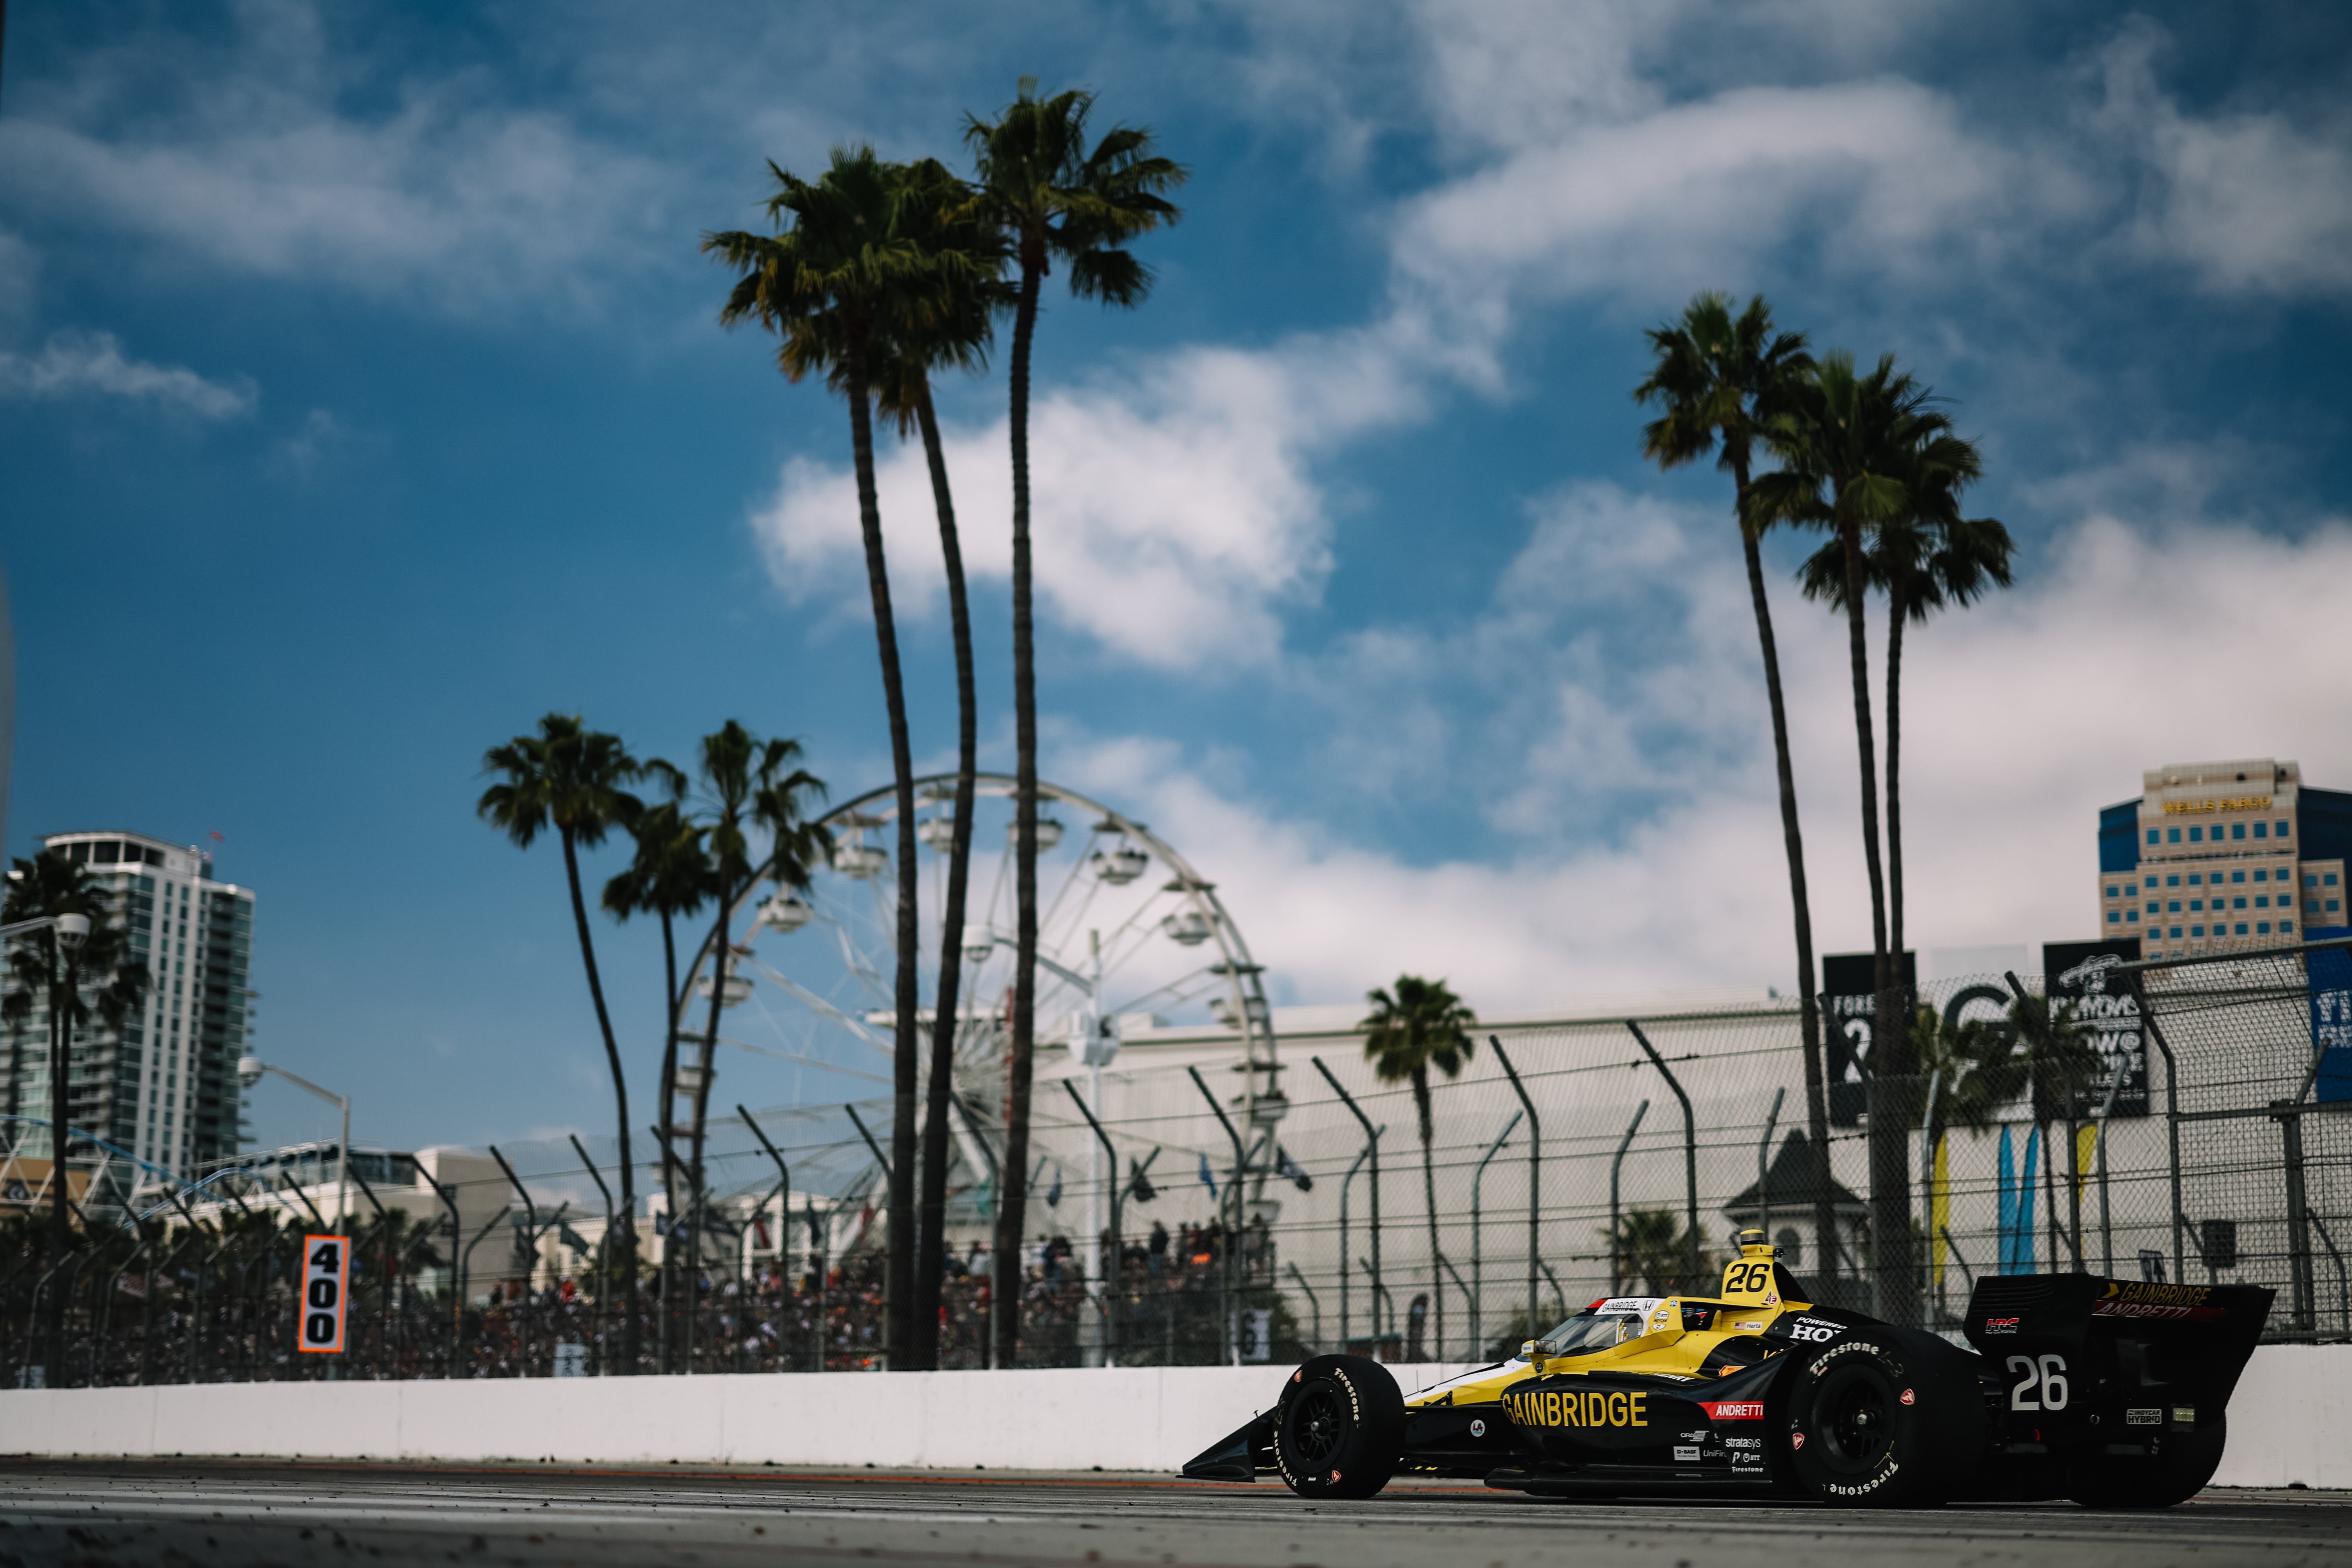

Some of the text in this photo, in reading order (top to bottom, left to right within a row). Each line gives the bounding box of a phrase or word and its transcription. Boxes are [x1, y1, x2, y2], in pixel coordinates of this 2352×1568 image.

[2219, 796, 2272, 812] FARGO
[1725, 1263, 1770, 1293] 26
[307, 1243, 339, 1343] 400
[2120, 1283, 2211, 1306] GAINBRIDGE
[1602, 1301, 1637, 1312] GAINBRIDGE
[2094, 1303, 2192, 1318] ANDRETTI
[1789, 1324, 1842, 1342] HO
[1796, 1317, 1848, 1329] POWERED
[1985, 1318, 2020, 1331] HRC
[1809, 1341, 1880, 1375] Firestone
[2006, 1354, 2068, 1410] 26
[1334, 1367, 1359, 1421] Firestone
[1503, 1392, 1648, 1427] GAINBRIDGE
[1715, 1405, 1764, 1416] ANDRETTI
[1725, 1437, 1761, 1450] stratasys
[1274, 1430, 1298, 1486] Firestone
[1830, 1461, 1899, 1496] Firestone
